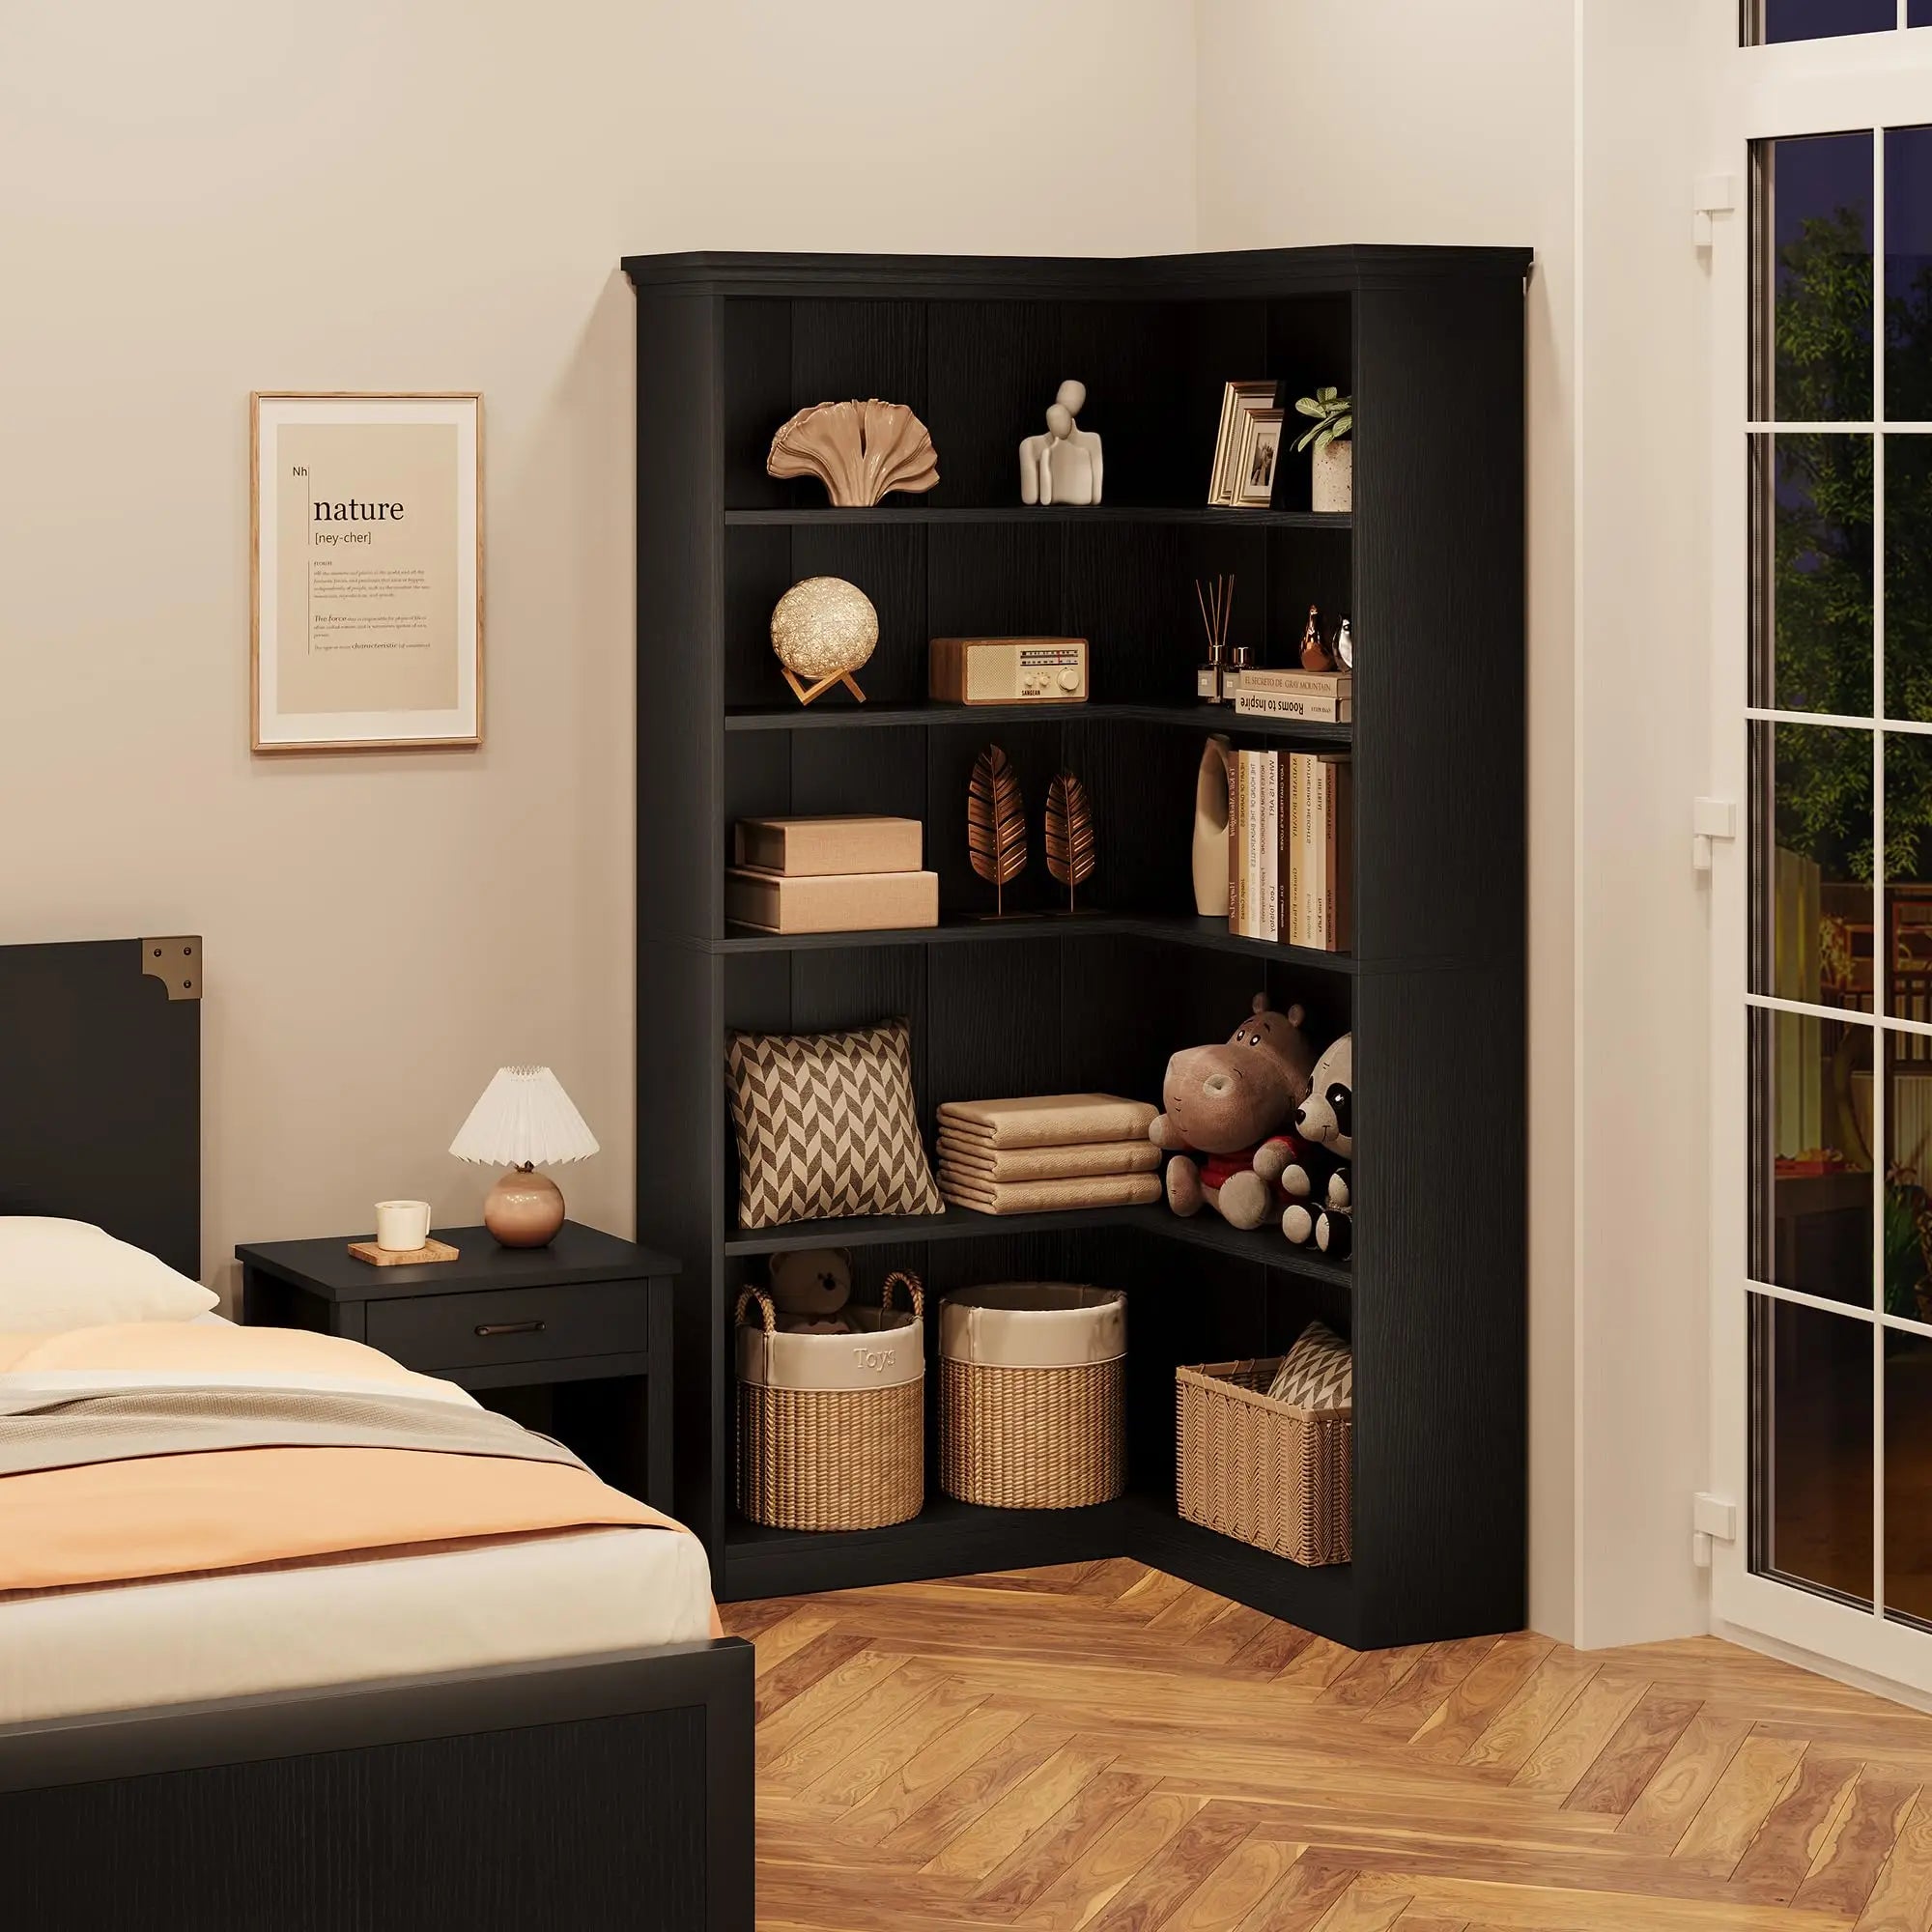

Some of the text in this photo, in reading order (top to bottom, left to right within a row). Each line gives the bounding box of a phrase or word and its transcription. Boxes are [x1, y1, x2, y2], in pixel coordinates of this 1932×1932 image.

[293, 466, 308, 476] Nh
[313, 498, 405, 522] nature
[315, 531, 372, 547] [ney-cher]
[328, 614, 347, 624] force
[351, 641, 396, 650] characteristic
[1244, 676, 1331, 692] EL SECRETO DE GRAY MOUNTAIN
[1240, 696, 1266, 712] Inspire
[1267, 700, 1276, 711] to
[1278, 700, 1304, 715] Rooms
[853, 1348, 895, 1373] Toys
